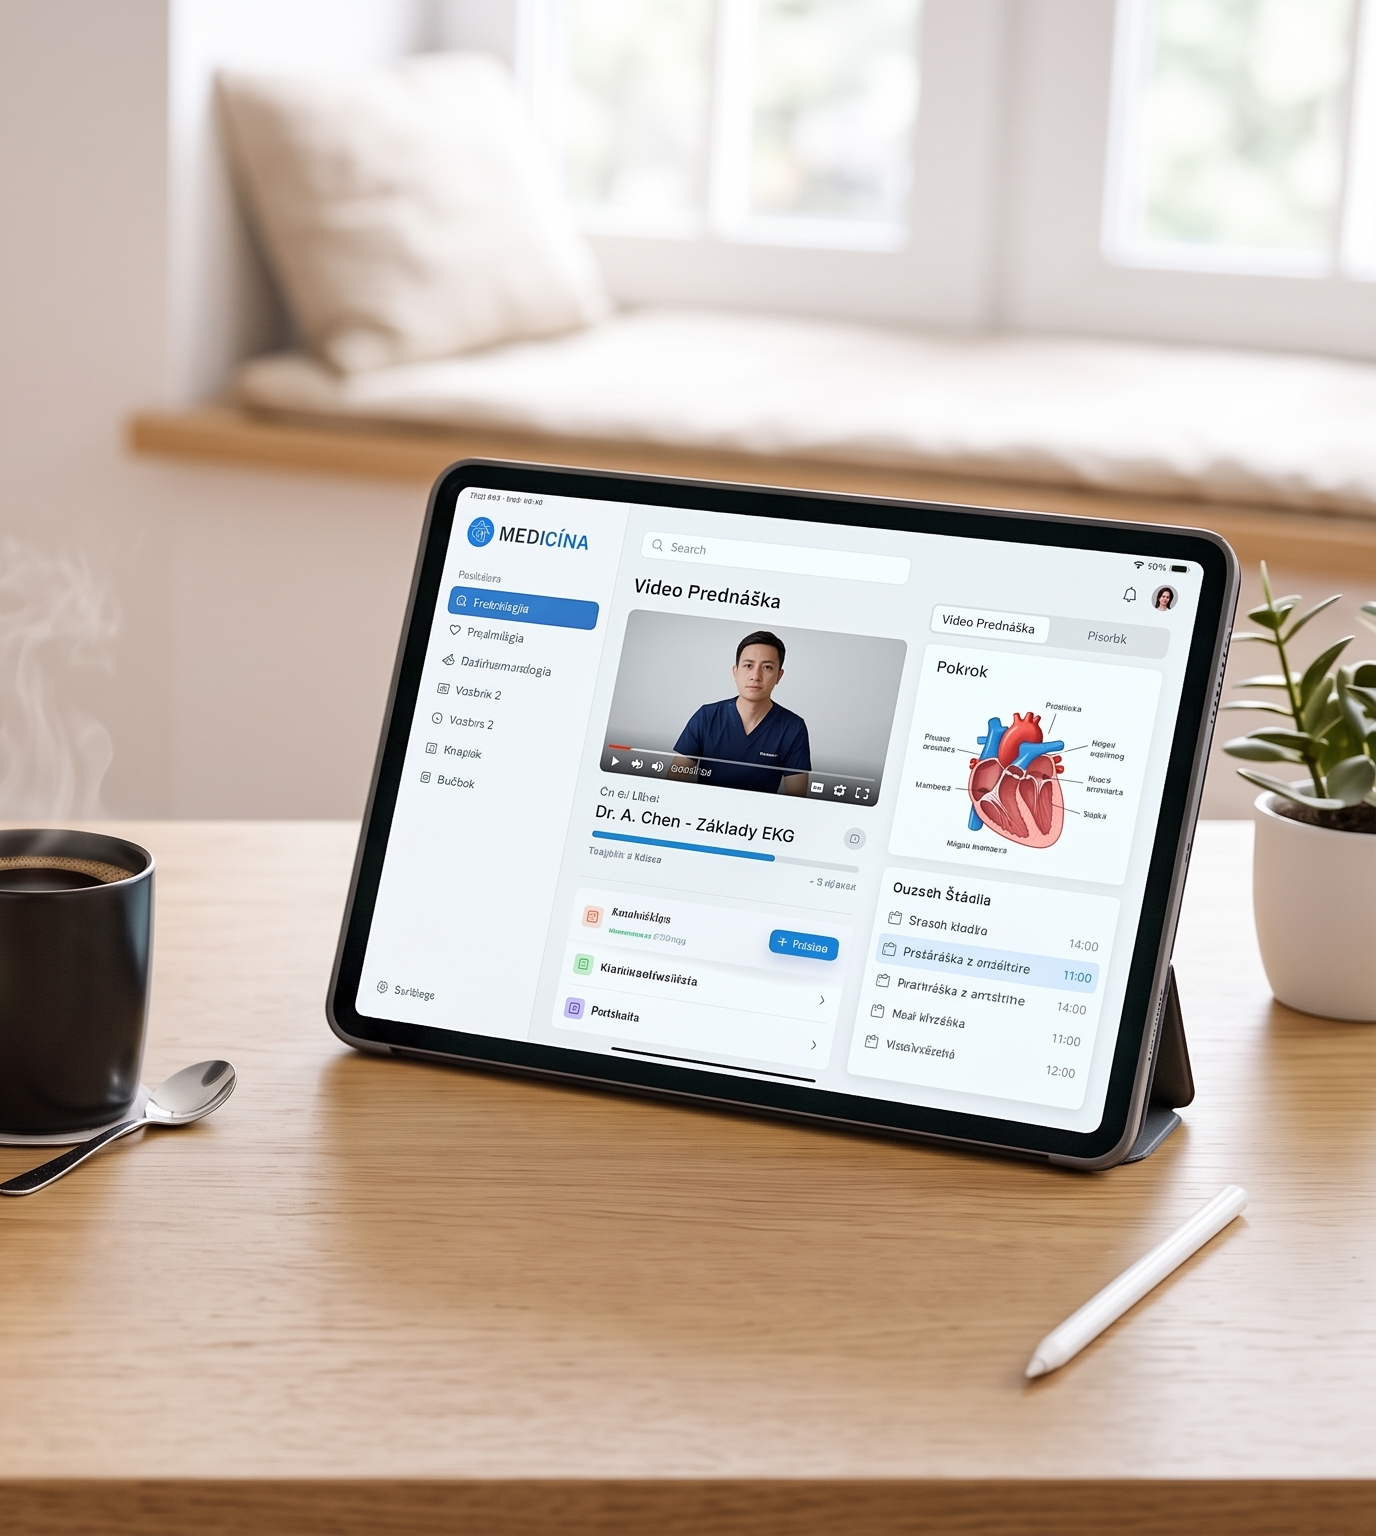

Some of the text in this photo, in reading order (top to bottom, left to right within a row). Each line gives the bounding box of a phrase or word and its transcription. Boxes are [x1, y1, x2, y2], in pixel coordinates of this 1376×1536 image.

[499, 526, 589, 551] MEDICÍNA
[670, 542, 707, 556] Search
[634, 577, 781, 610] Video Prednáška
[942, 614, 1036, 636] Video Prednáška
[936, 660, 989, 679] Pokrok
[494, 690, 502, 701] 2
[487, 719, 494, 730] 2
[595, 804, 616, 820] Dr.
[620, 808, 636, 823] A.
[641, 810, 681, 829] Chen
[696, 817, 759, 841] Základy
[762, 826, 796, 843] EKG
[1069, 938, 1100, 953] 14:00
[1063, 969, 1093, 984] 11:00
[1057, 1001, 1088, 1016] 14:00
[1051, 1033, 1082, 1047] 11:00
[1046, 1064, 1076, 1079] 12:00
